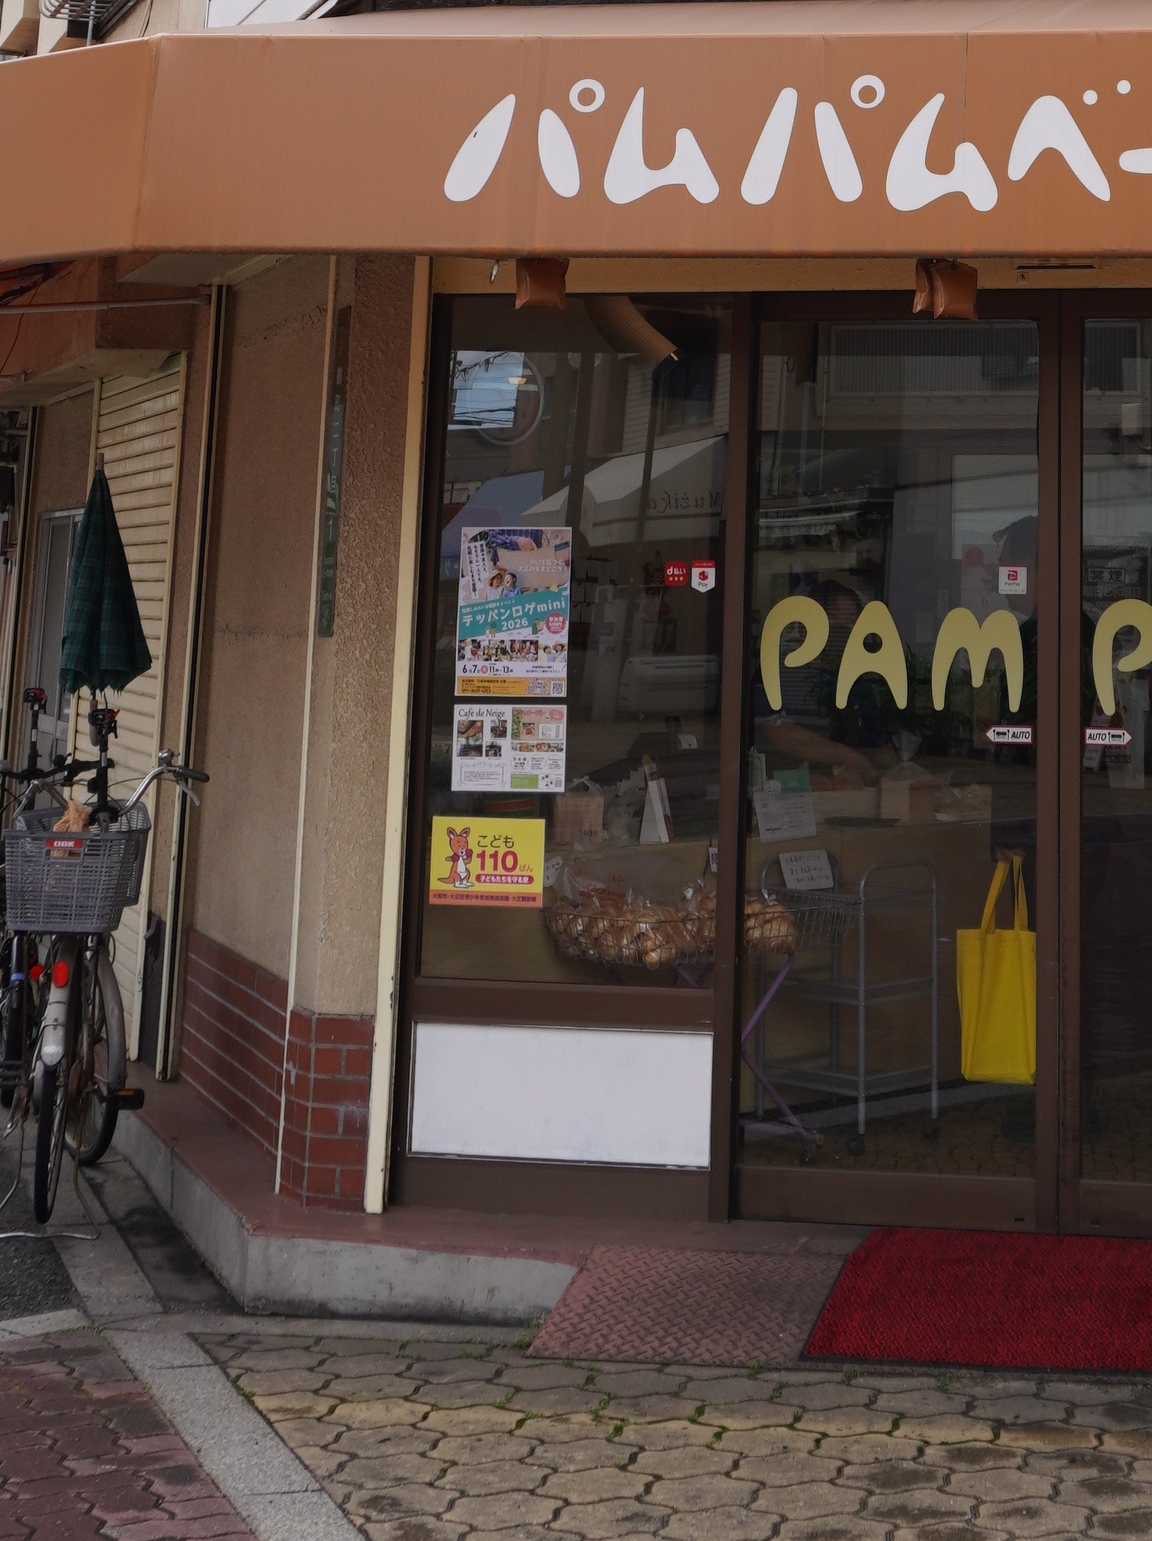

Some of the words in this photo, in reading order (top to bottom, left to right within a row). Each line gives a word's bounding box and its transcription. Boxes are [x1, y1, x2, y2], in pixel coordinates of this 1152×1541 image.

[502, 618, 528, 630] 2026
[760, 595, 1024, 713] PAM
[476, 708, 485, 718] de
[486, 709, 505, 720] Neige
[1011, 730, 1031, 740] AUTO
[1087, 732, 1107, 742] AUTO
[477, 835, 515, 849] こども
[477, 850, 519, 873] 110
[519, 864, 534, 873] ばん
